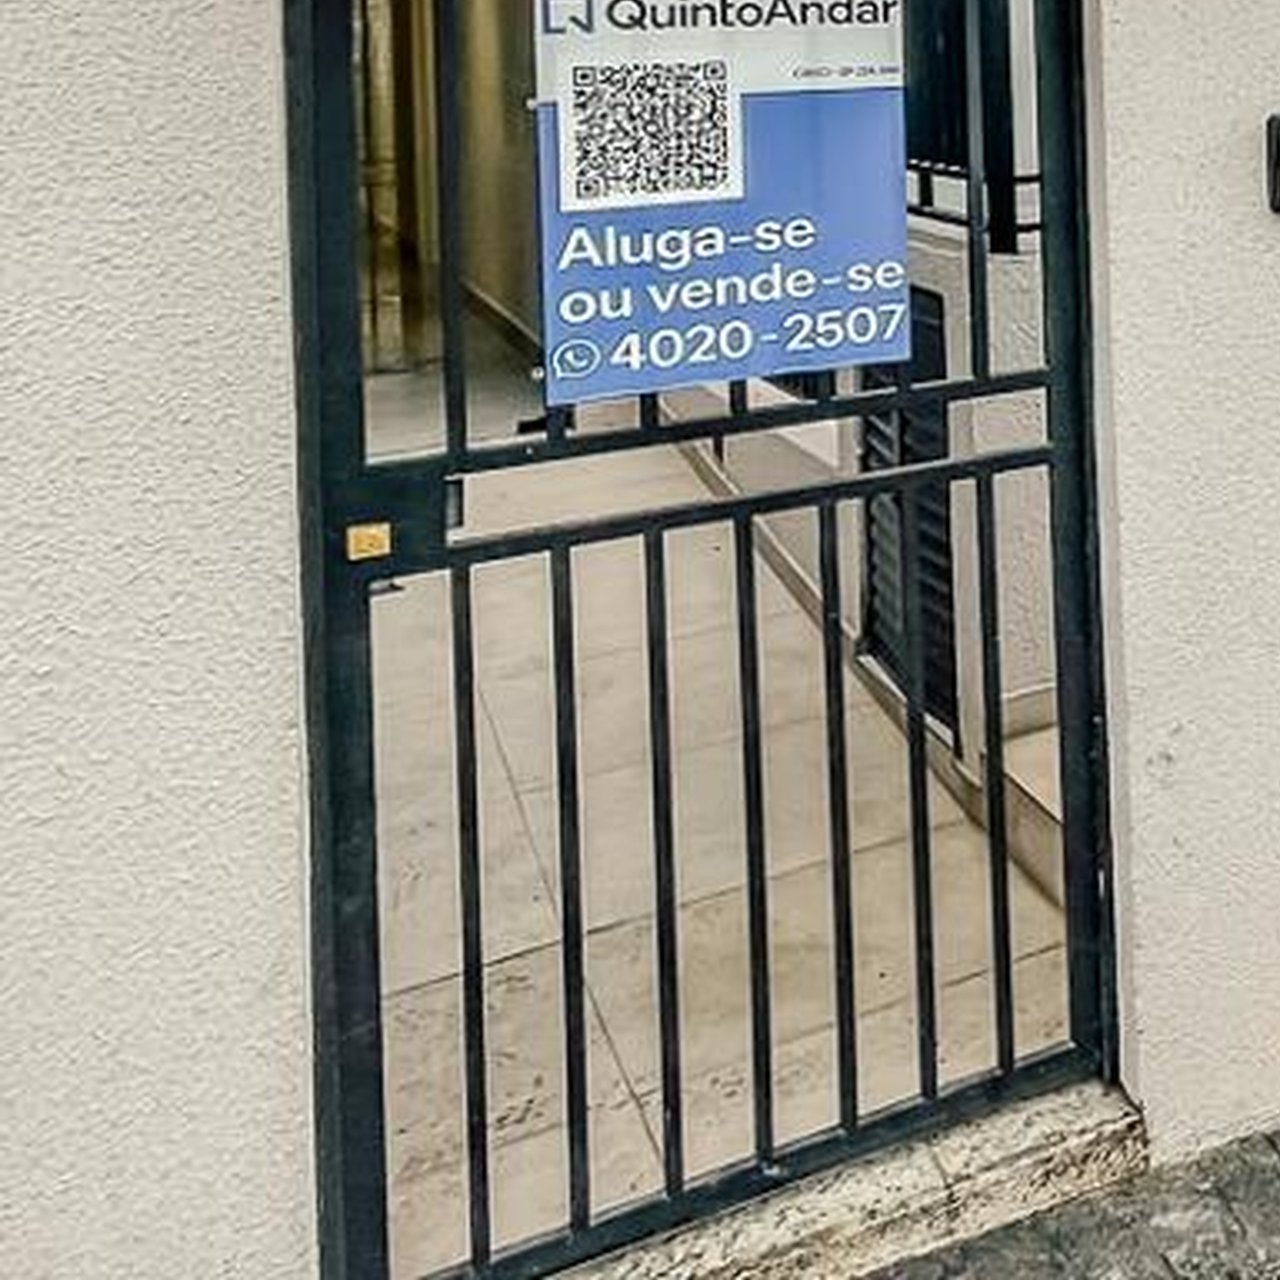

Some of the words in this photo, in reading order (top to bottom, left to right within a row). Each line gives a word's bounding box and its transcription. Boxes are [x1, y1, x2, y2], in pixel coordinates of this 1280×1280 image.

[558, 217, 817, 271] Aluga-se
[559, 290, 632, 324] ou
[646, 259, 906, 315] vende-se
[609, 303, 906, 372] 4020-2507
